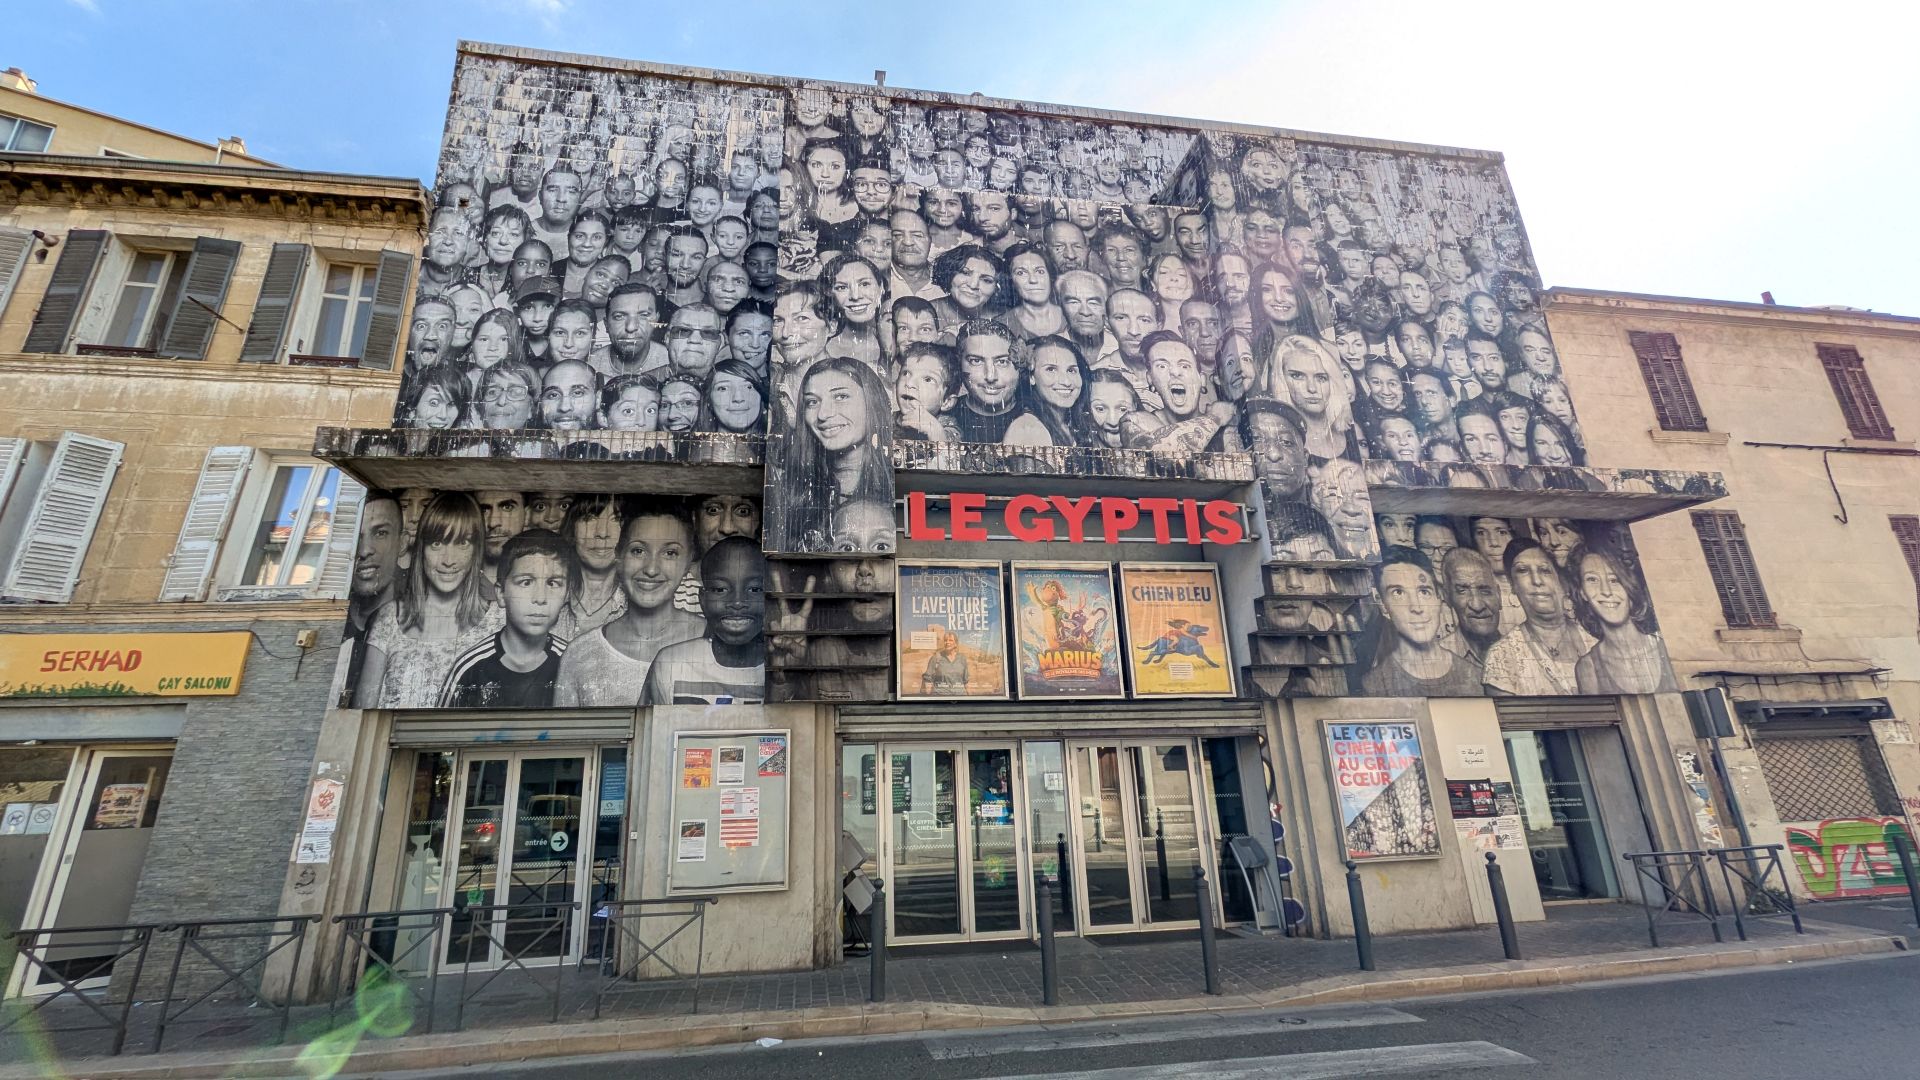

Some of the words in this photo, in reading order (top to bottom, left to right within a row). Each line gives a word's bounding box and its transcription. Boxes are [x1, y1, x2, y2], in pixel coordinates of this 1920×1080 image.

[910, 491, 988, 541] LE
[1004, 494, 1243, 545] GYPTIS
[1131, 586, 1174, 602] CHIEN
[1176, 586, 1212, 602] BLEU
[912, 596, 989, 614] L'AVENTURE
[40, 650, 142, 672] SERHAD
[1037, 650, 1102, 670] MARIUS
[158, 677, 181, 692] ÇAY
[184, 676, 232, 690] SALONU
[1332, 726, 1351, 740] LE
[1355, 726, 1413, 740] GYPTIS
[1338, 757, 1360, 771] AU
[1340, 772, 1392, 786] CŒUR
